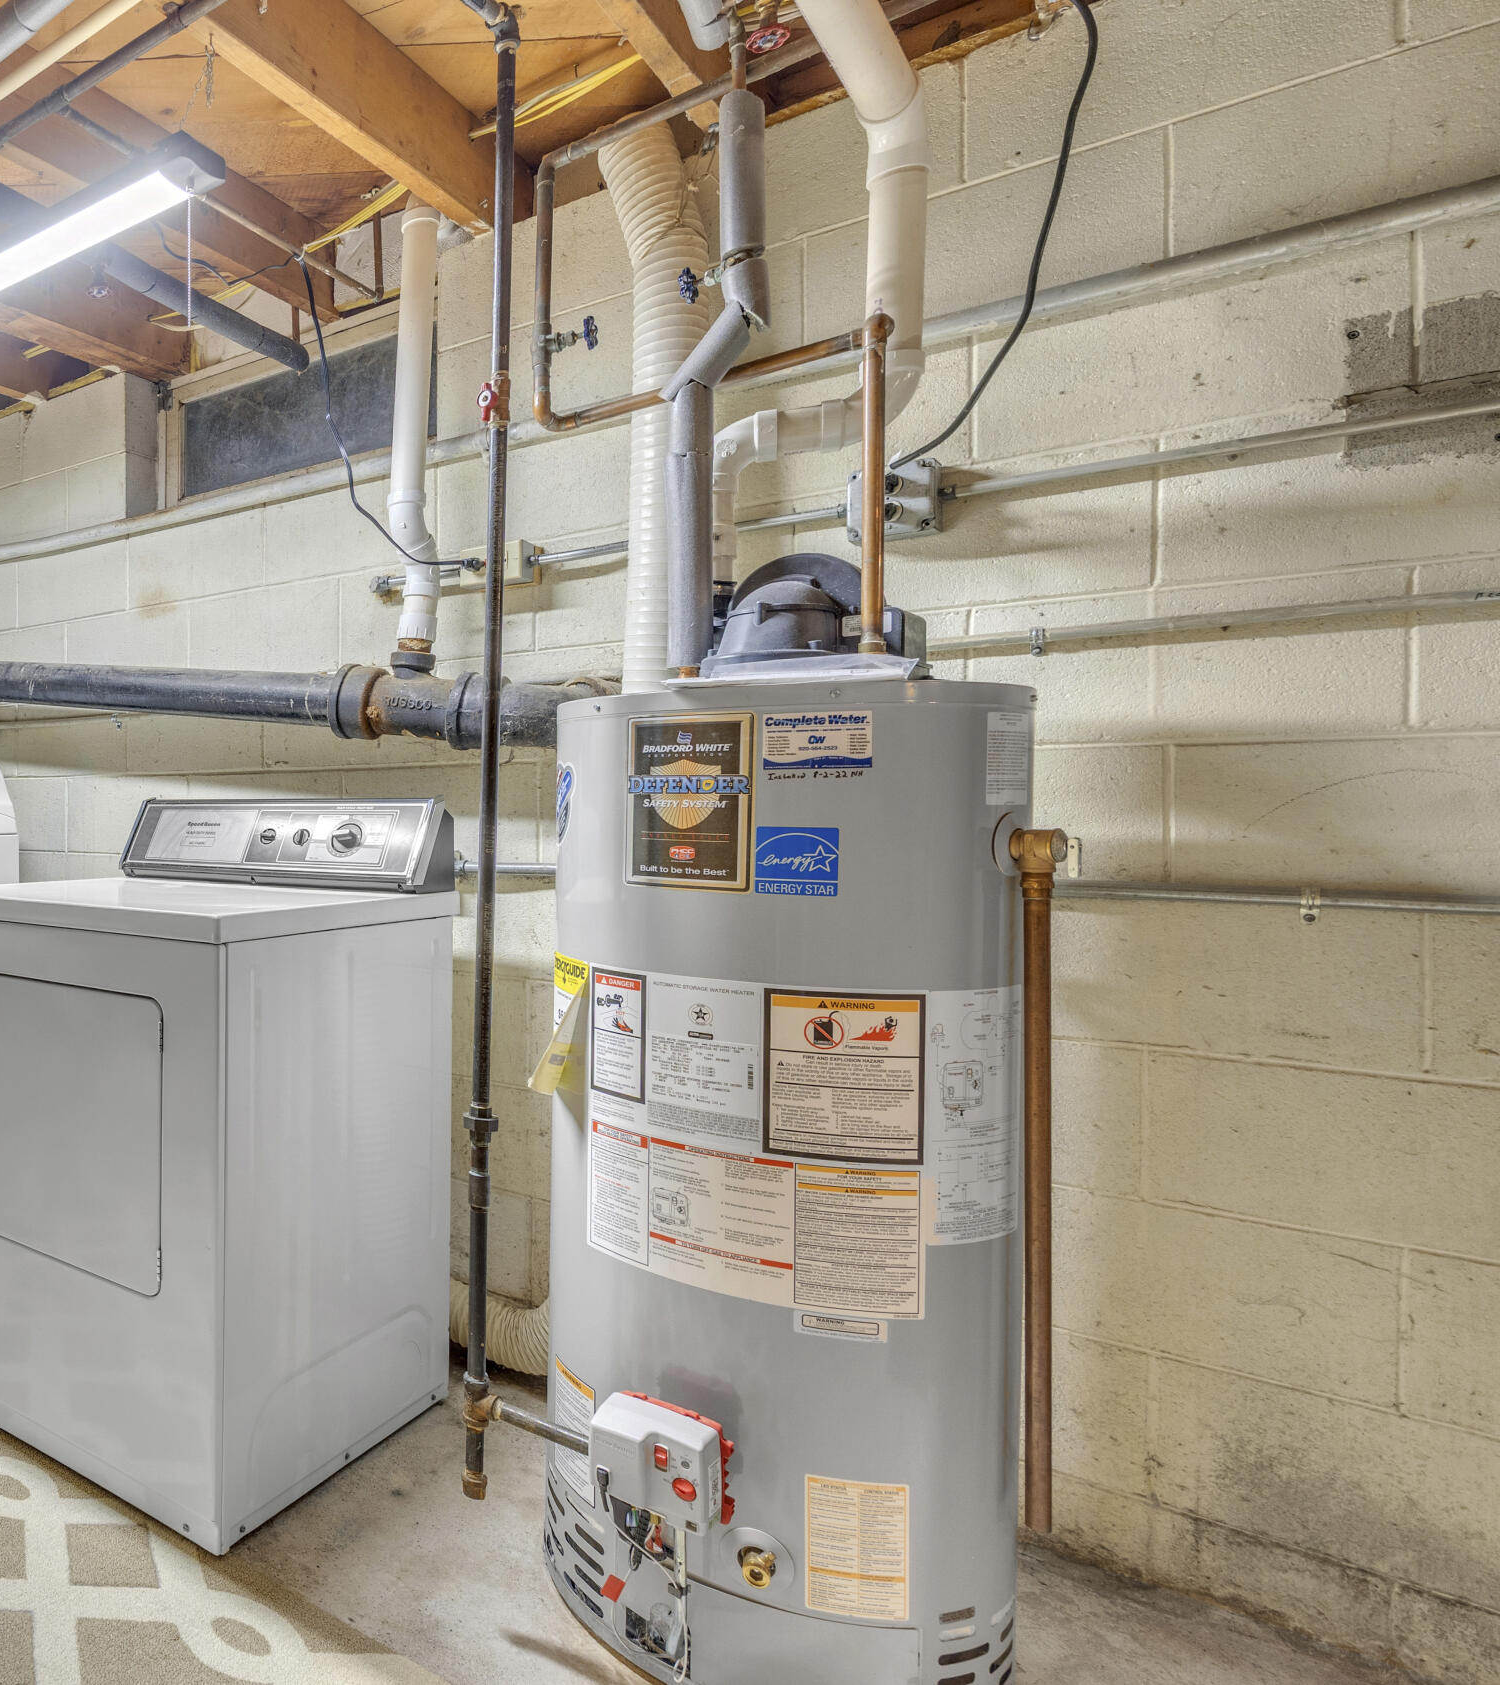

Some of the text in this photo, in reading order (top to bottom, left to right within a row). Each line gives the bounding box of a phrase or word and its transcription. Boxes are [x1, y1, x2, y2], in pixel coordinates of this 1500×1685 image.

[764, 714, 867, 729] Complete Water
[642, 743, 731, 754] BRADFORD WHITE
[813, 770, 848, 779] 8-2-22
[628, 775, 750, 795] DEFENDER
[642, 798, 728, 810] SAFETY SYSTEM
[757, 854, 816, 873] energy
[639, 864, 727, 877] Built to be the Best
[758, 882, 835, 896] ENERGY STAR
[608, 977, 635, 989] DANGER
[653, 981, 755, 997] AUTOMATIC STORAGE WATER HEATER
[830, 1001, 876, 1010] WARNING
[844, 1043, 871, 1051] Flammable
[850, 1169, 877, 1177] WARNING
[850, 1188, 877, 1196] WARNING
[816, 1317, 845, 1326] WARNING
